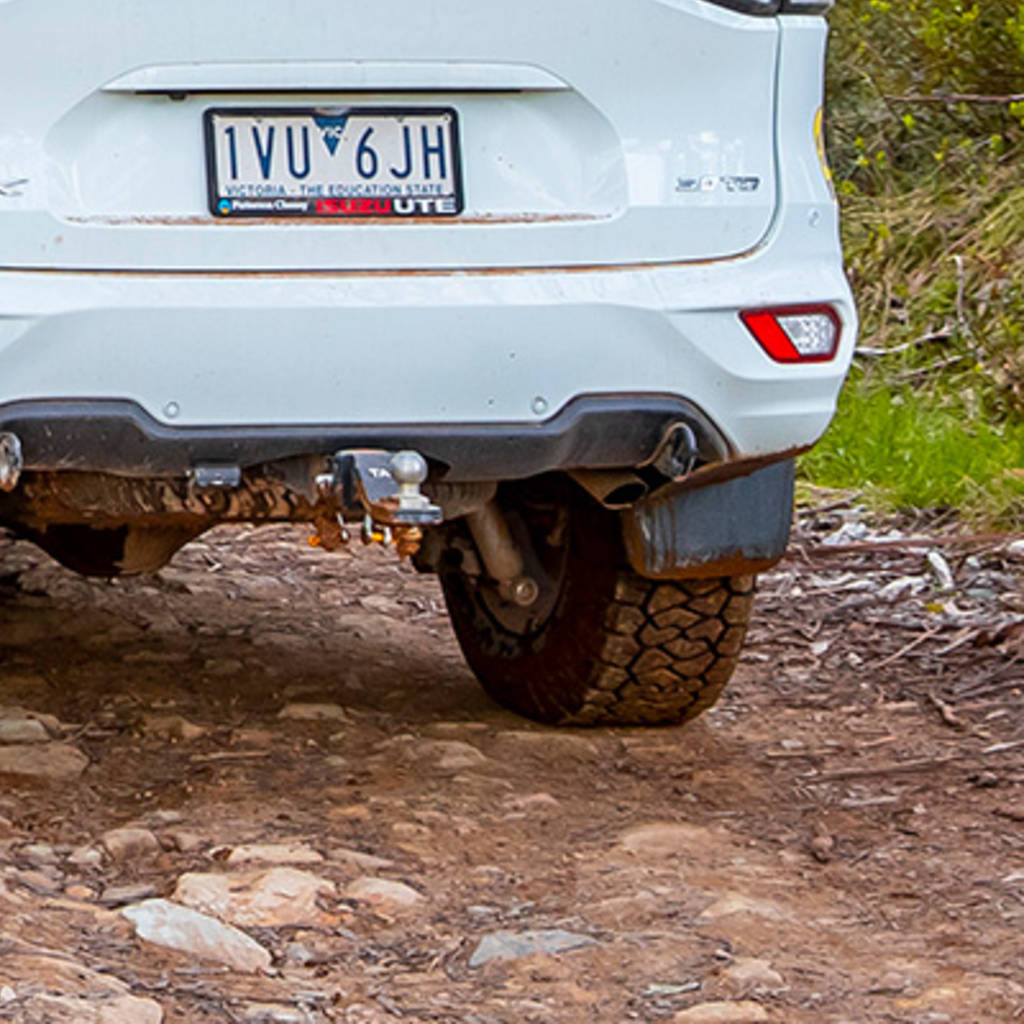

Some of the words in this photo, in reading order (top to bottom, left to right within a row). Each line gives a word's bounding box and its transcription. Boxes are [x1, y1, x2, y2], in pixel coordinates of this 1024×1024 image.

[225, 125, 311, 180] 1VU
[355, 125, 447, 180] 6JH
[226, 184, 287, 196] VICTORIA
[300, 183, 322, 196] THE
[328, 184, 403, 196] EDUCATION
[405, 184, 443, 196] STATE
[315, 198, 391, 215] ISUZU
[393, 197, 457, 214] UTE
